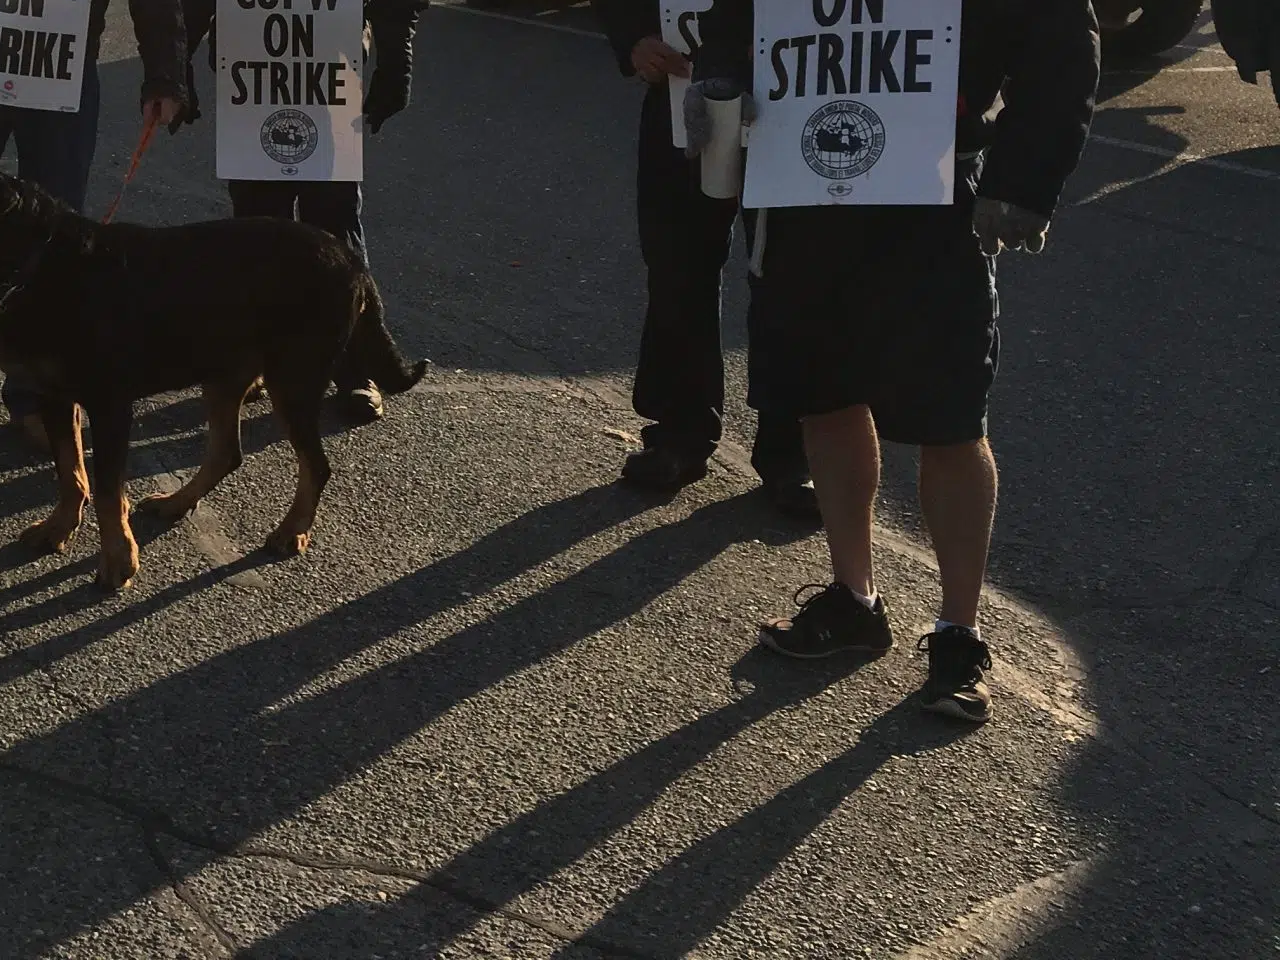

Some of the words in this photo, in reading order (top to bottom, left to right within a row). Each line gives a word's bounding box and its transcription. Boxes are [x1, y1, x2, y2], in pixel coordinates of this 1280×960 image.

[264, 14, 314, 58] ON
[231, 62, 346, 106] STRIKE
[769, 29, 934, 101] STRIKE
